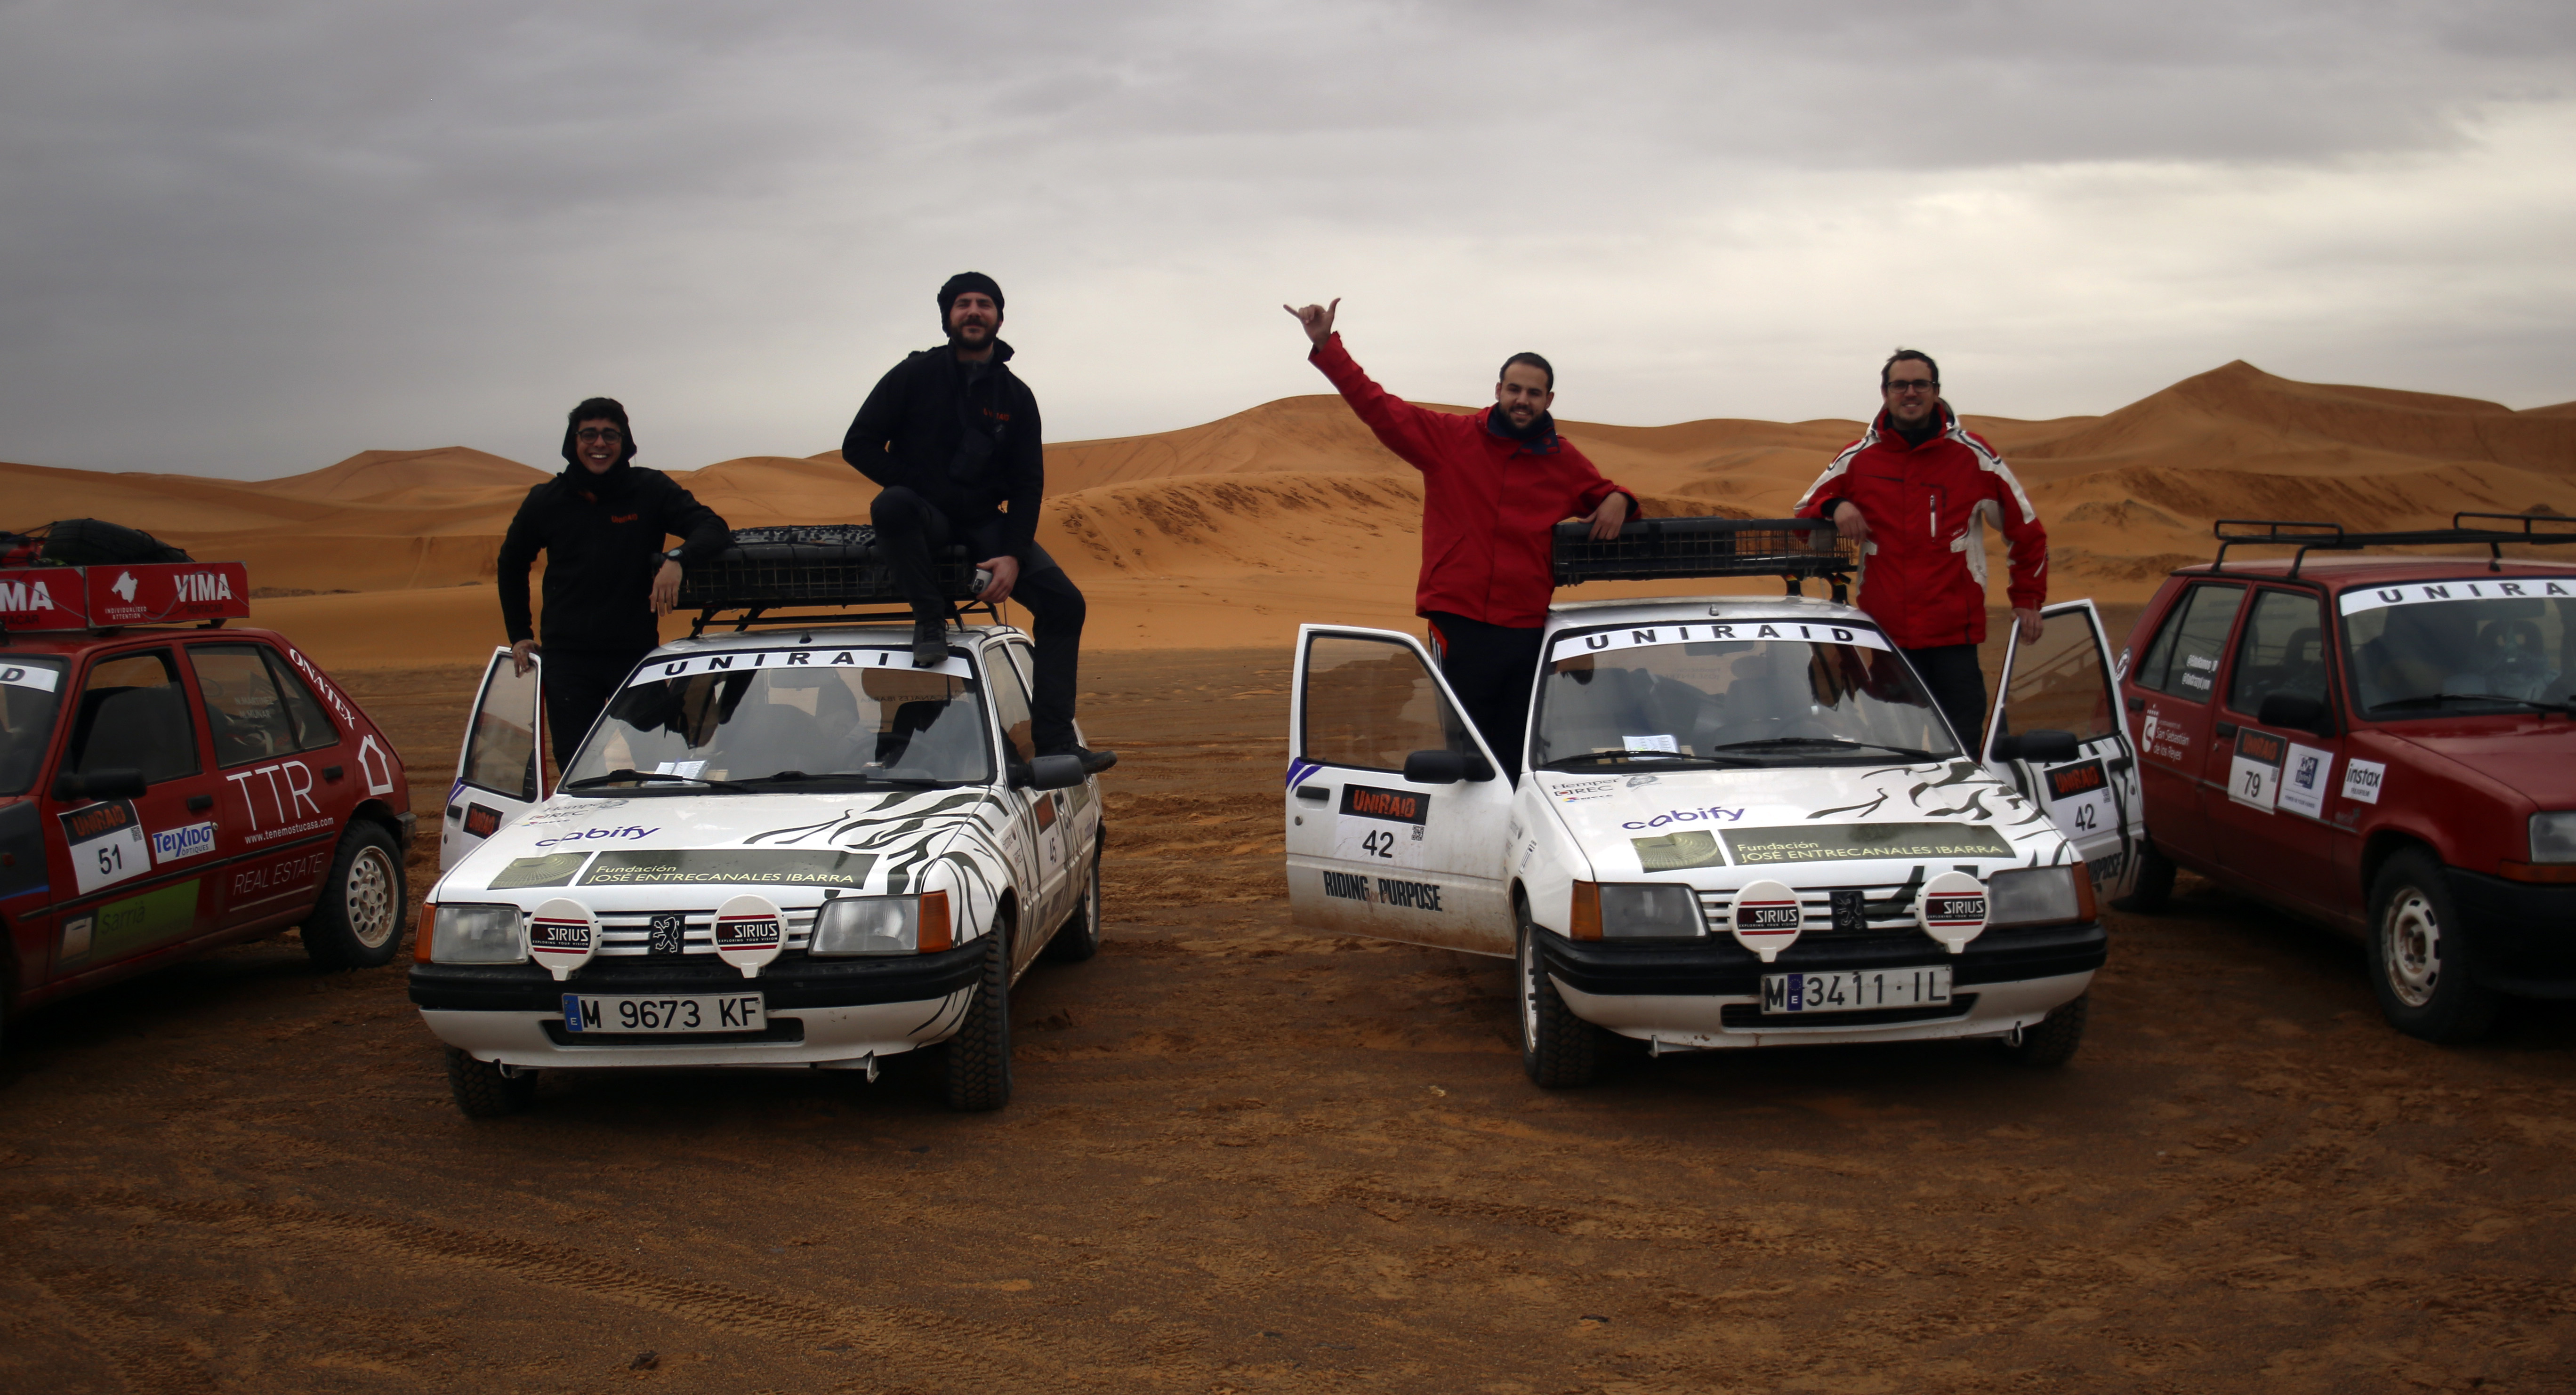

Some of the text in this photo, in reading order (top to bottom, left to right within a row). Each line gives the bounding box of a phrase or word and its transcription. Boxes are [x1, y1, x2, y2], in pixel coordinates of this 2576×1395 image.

[174, 573, 232, 602] VIMA
[1586, 625, 1853, 651] UNIRAID
[289, 649, 355, 730] ONATEX
[2156, 727, 2165, 739] San
[2153, 742, 2160, 755] de
[2168, 746, 2182, 762] Reyes
[1552, 778, 1619, 790] Hemper
[2054, 765, 2100, 794] UNIRAID
[2244, 770, 2261, 798] 79
[2346, 763, 2381, 788] instax
[226, 760, 321, 831] TTR
[1353, 790, 1416, 818] UNIRAID
[72, 804, 126, 837] UNIRAID
[245, 817, 334, 844] www.tenemostucasa.com
[1621, 806, 1745, 830] cabify
[2075, 803, 2096, 832] 42
[535, 825, 661, 847] cabify
[1362, 829, 1394, 858] 42
[1738, 841, 1819, 851] Fundación
[98, 843, 121, 875] 51
[1049, 837, 1057, 865] 45
[1740, 844, 2003, 863] JOSÉ ENTRECANALES IBARRA
[233, 852, 324, 896] REAL ESTATE
[586, 872, 854, 884] JOSÉ ENTRECANALES IBARRA
[596, 864, 676, 873] Fundación
[1323, 871, 1370, 902] RIDING
[1377, 878, 1443, 912] PURPOSE
[1755, 909, 1797, 923] SIRIUS
[1943, 900, 1984, 914] SIRIUS
[547, 928, 588, 942] SIRIUS
[734, 923, 778, 938] SIRIUS
[1764, 971, 1946, 1011] M 3411 IL
[1791, 995, 1798, 1003] E
[570, 1018, 578, 1026] E
[580, 997, 759, 1029] M 9673 KF
